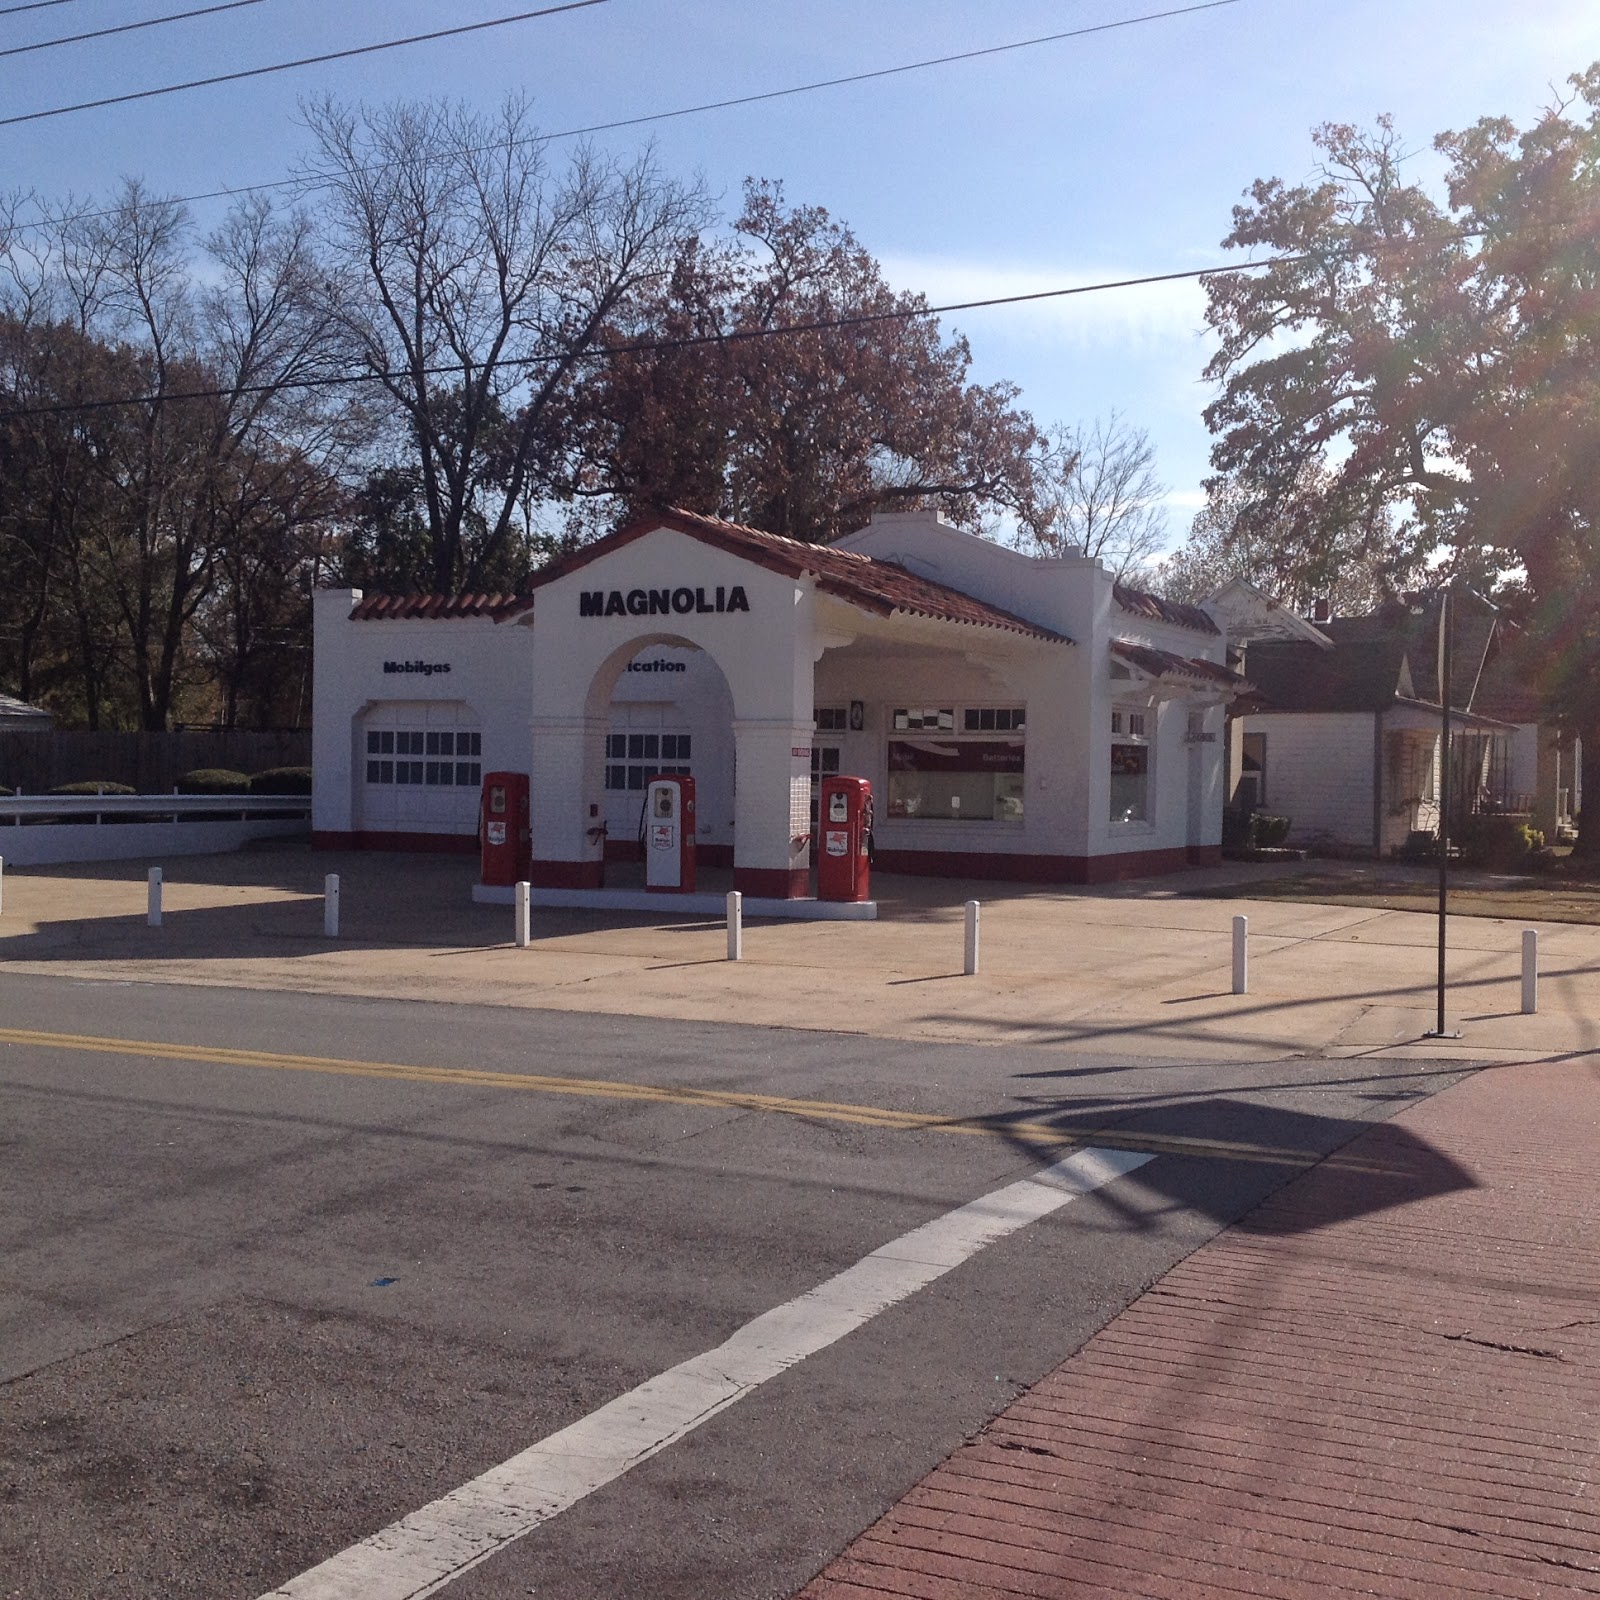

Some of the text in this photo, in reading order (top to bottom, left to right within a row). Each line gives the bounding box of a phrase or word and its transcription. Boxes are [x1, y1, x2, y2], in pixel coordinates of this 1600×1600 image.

[580, 585, 750, 616] MAGNOLIA
[383, 660, 451, 676] Mobilgas
[624, 658, 686, 673] ication
